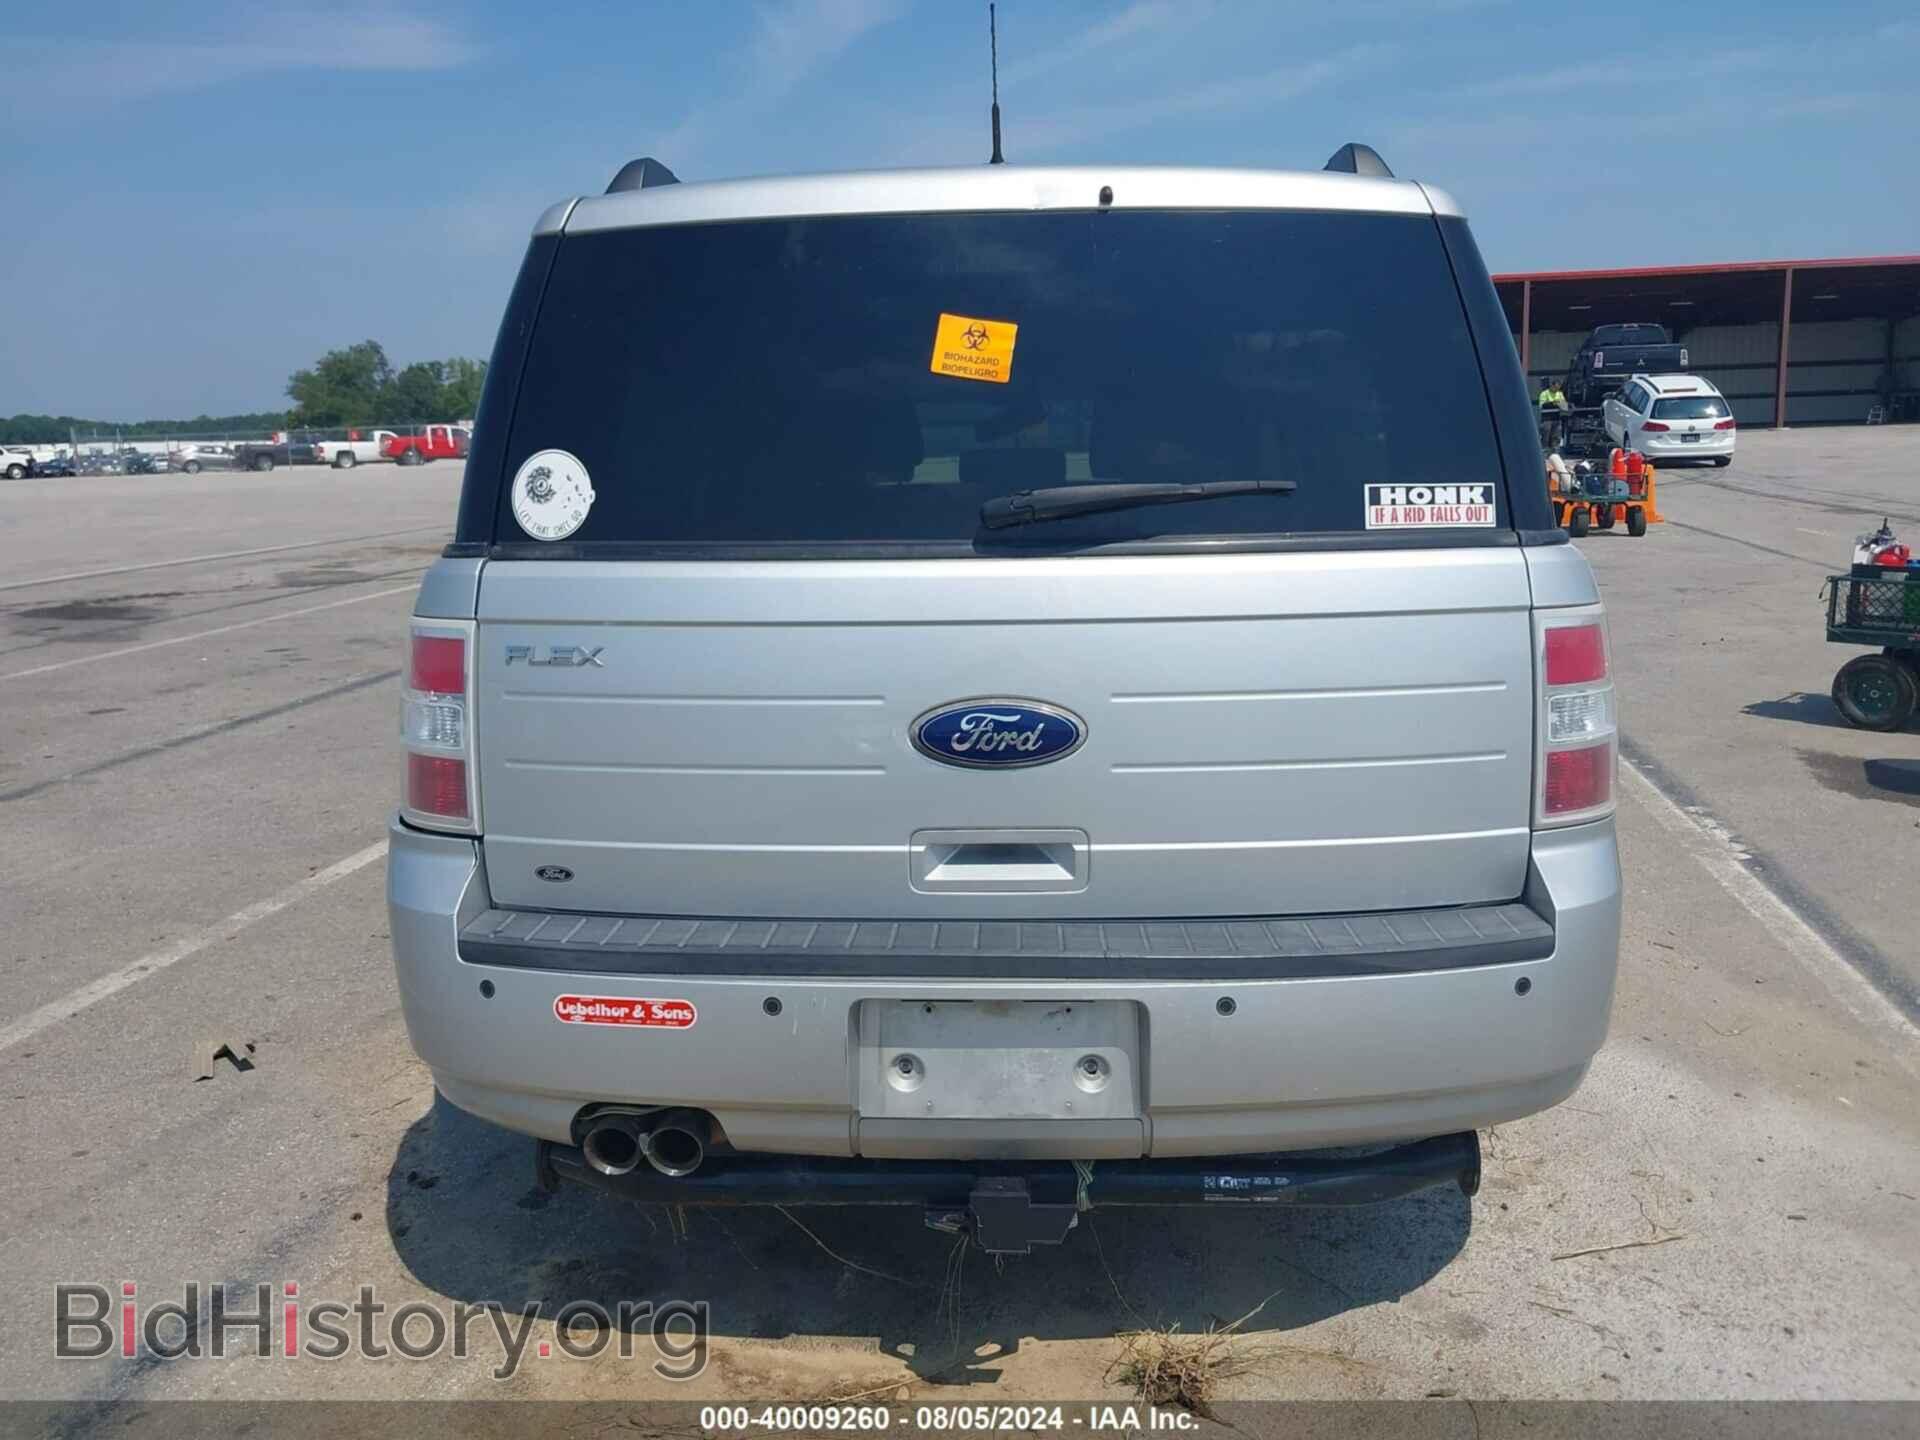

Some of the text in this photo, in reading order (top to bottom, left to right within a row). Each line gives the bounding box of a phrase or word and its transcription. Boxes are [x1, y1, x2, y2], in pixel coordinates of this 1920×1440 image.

[943, 351, 1000, 367] BIOHAZARD
[941, 362, 999, 378] BIOPELIGRO
[1379, 486, 1486, 505] HONK
[1375, 506, 1489, 523] IF A KID FALLS OUT
[505, 646, 605, 667] FLEX
[950, 712, 1046, 752] Ford
[632, 1004, 646, 1019] &
[652, 1004, 693, 1020] Sons
